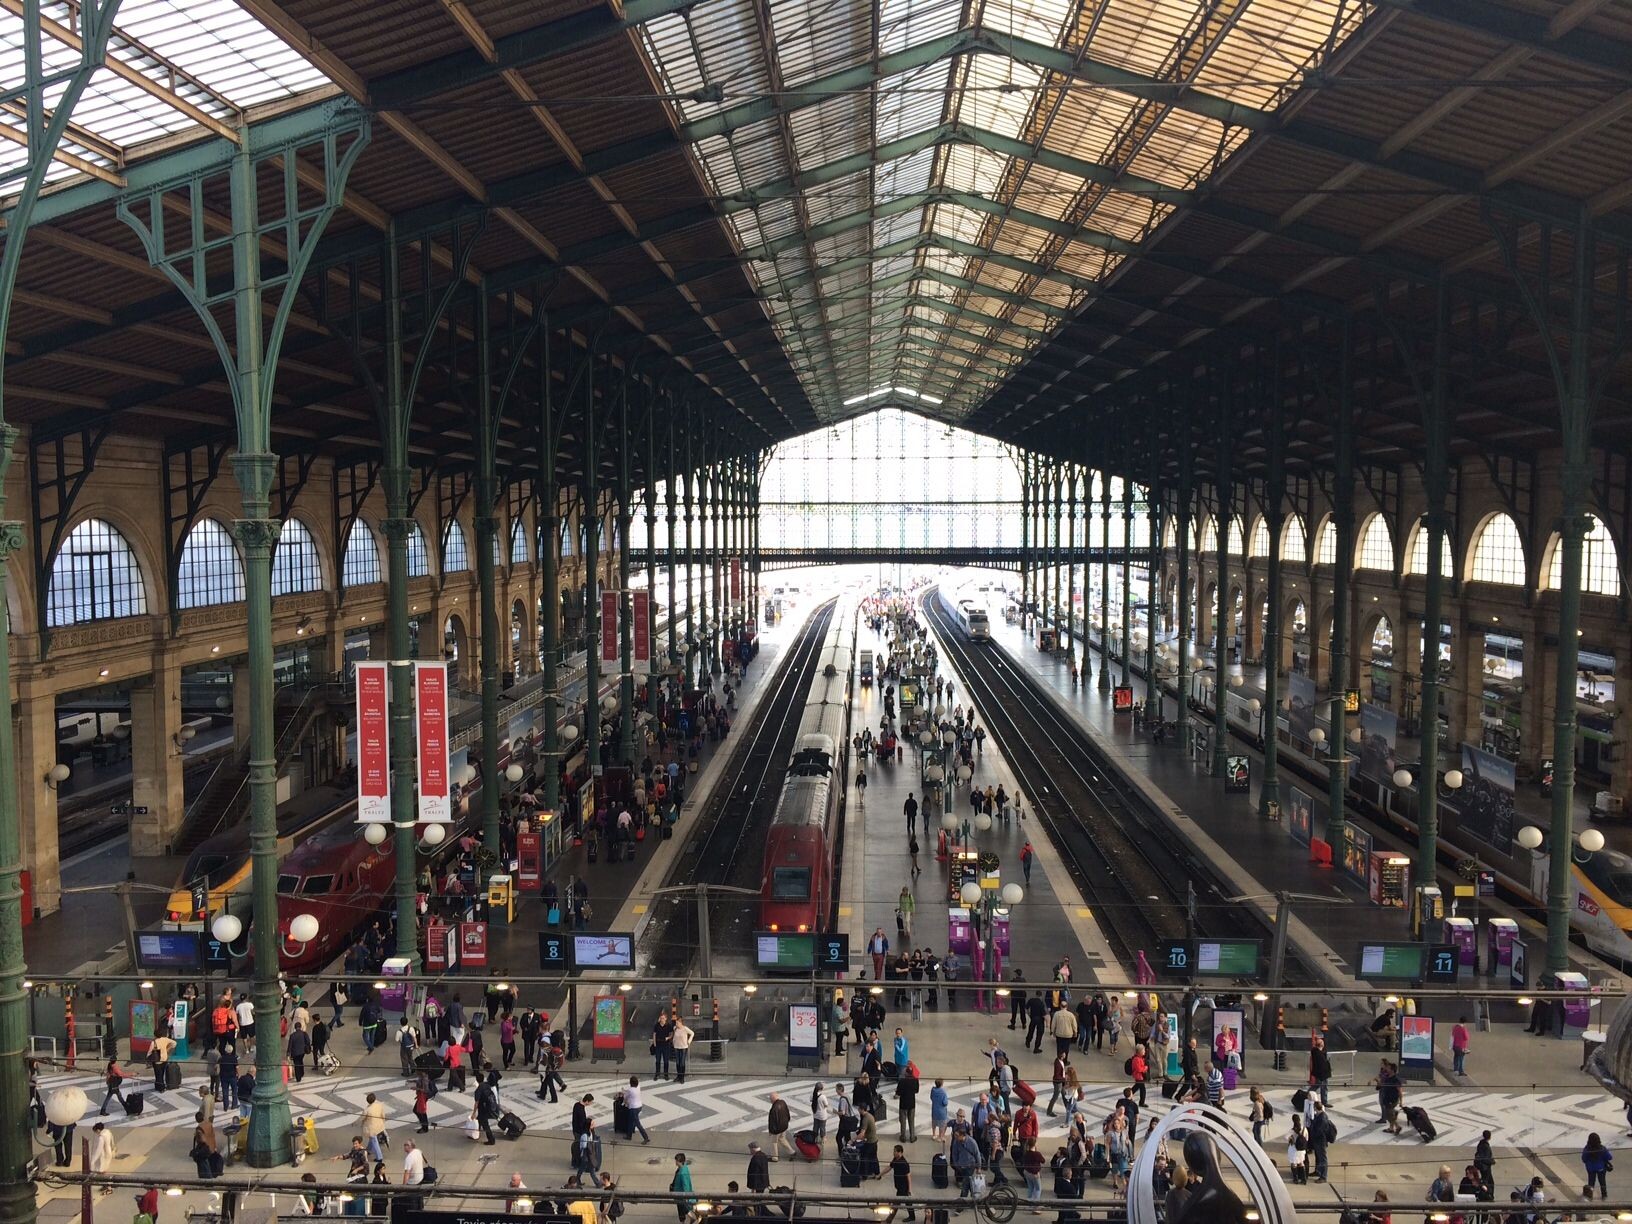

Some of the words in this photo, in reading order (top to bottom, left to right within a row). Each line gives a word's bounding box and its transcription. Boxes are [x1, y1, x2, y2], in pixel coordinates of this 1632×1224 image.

[210, 946, 220, 958] 7
[549, 946, 558, 958] 8
[830, 948, 839, 960] 9
[1168, 953, 1187, 965] 10
[1435, 958, 1453, 971] 11
[796, 1015, 803, 1026] 3
[809, 1016, 816, 1027] 2
